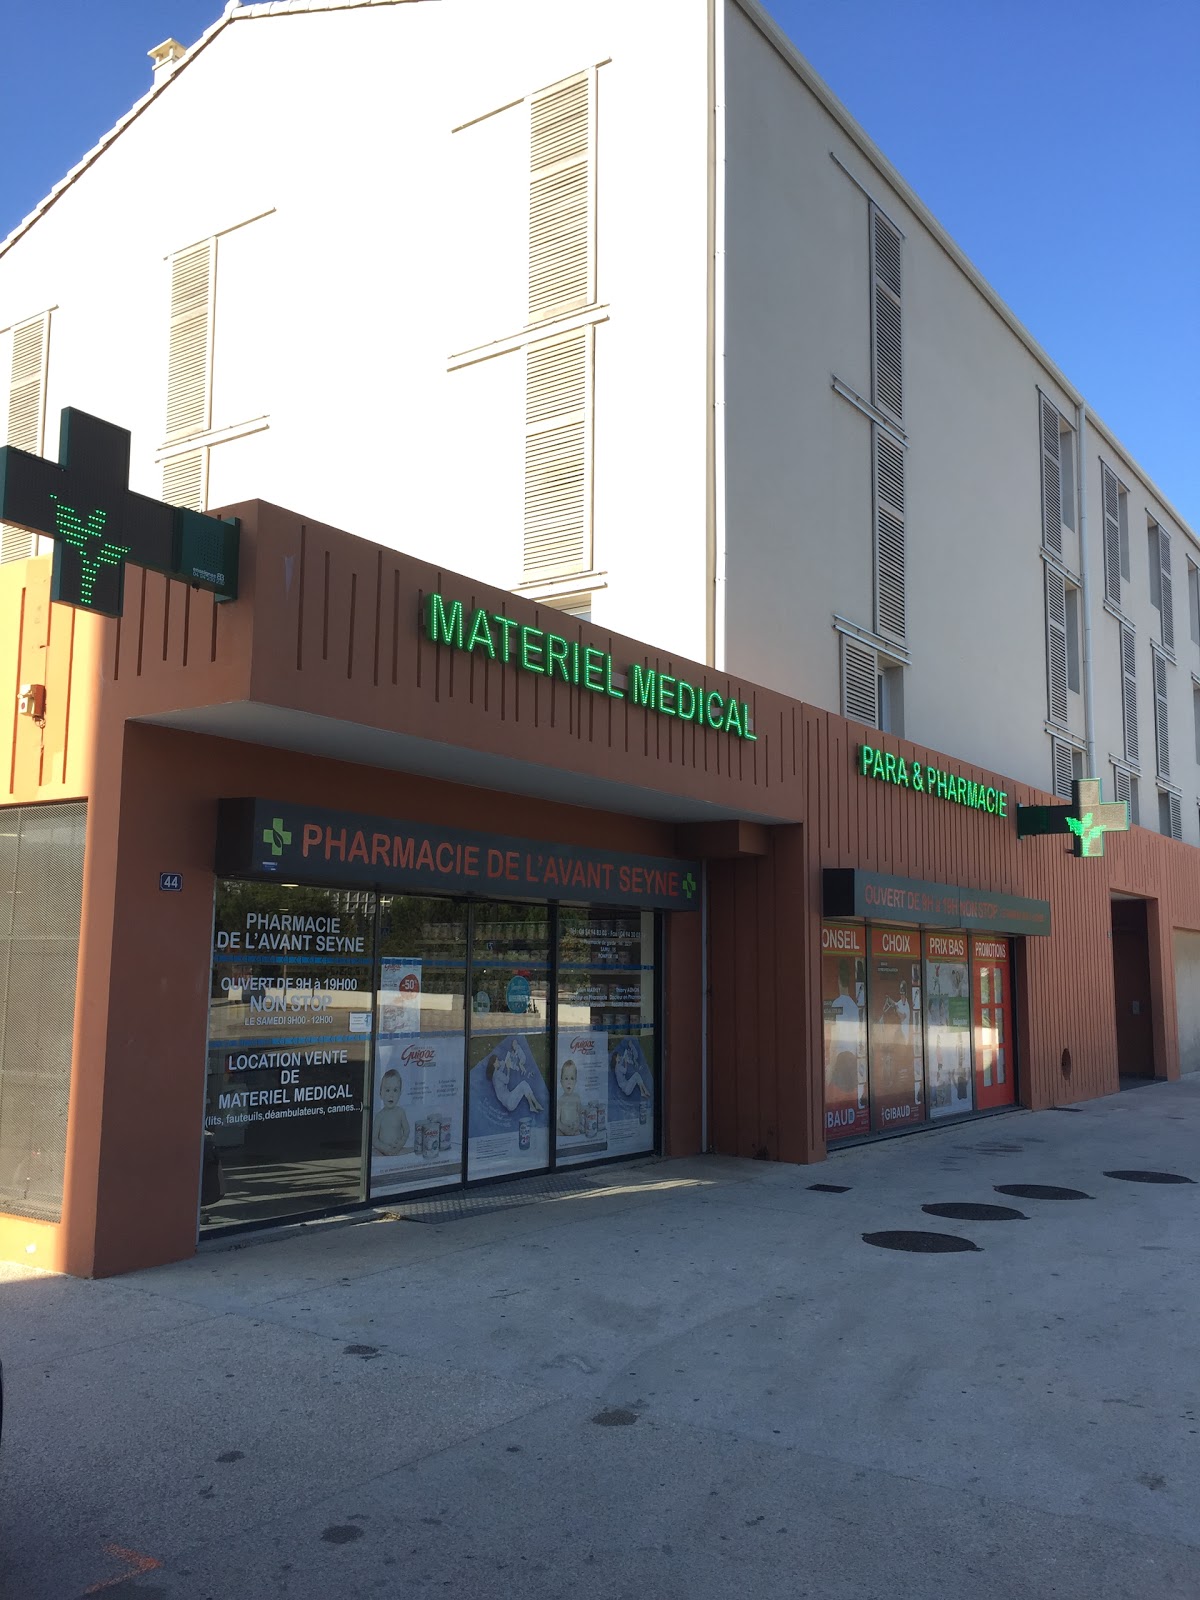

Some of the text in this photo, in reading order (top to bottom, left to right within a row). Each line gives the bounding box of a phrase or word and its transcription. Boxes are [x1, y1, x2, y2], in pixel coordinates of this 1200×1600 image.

[430, 593, 757, 740] MATERIEL MEDICAL
[860, 745, 1008, 817] PARA & PHARMACIE
[302, 823, 679, 897] PHARMACIE DE L'AVANT SEYNE
[164, 876, 178, 888] 44
[865, 885, 905, 908] OUVERT
[908, 891, 920, 911] DE
[960, 900, 977, 918] NON
[978, 901, 998, 920] STOP
[246, 912, 341, 934] PHARMACIE
[217, 931, 364, 952] DE L'AVANT SEYNE
[882, 934, 911, 952] CHOIX
[929, 937, 964, 956] PRIX BAS
[975, 942, 1006, 958] PROMOTIONS
[221, 977, 357, 991] OUVERT DE 9H à 19H00
[250, 995, 333, 1013] NON STOP
[245, 1018, 255, 1026] LE
[256, 1017, 286, 1026] SAMEDI
[287, 1016, 306, 1025] 9H00
[312, 1015, 333, 1024] 12H00
[228, 1050, 348, 1071] LOCATION VENTE
[280, 1069, 299, 1085] DE
[218, 1084, 353, 1109] MATERIEL MEDICAL
[205, 1116, 223, 1128] (lits,
[884, 1105, 911, 1121] GIBAUD
